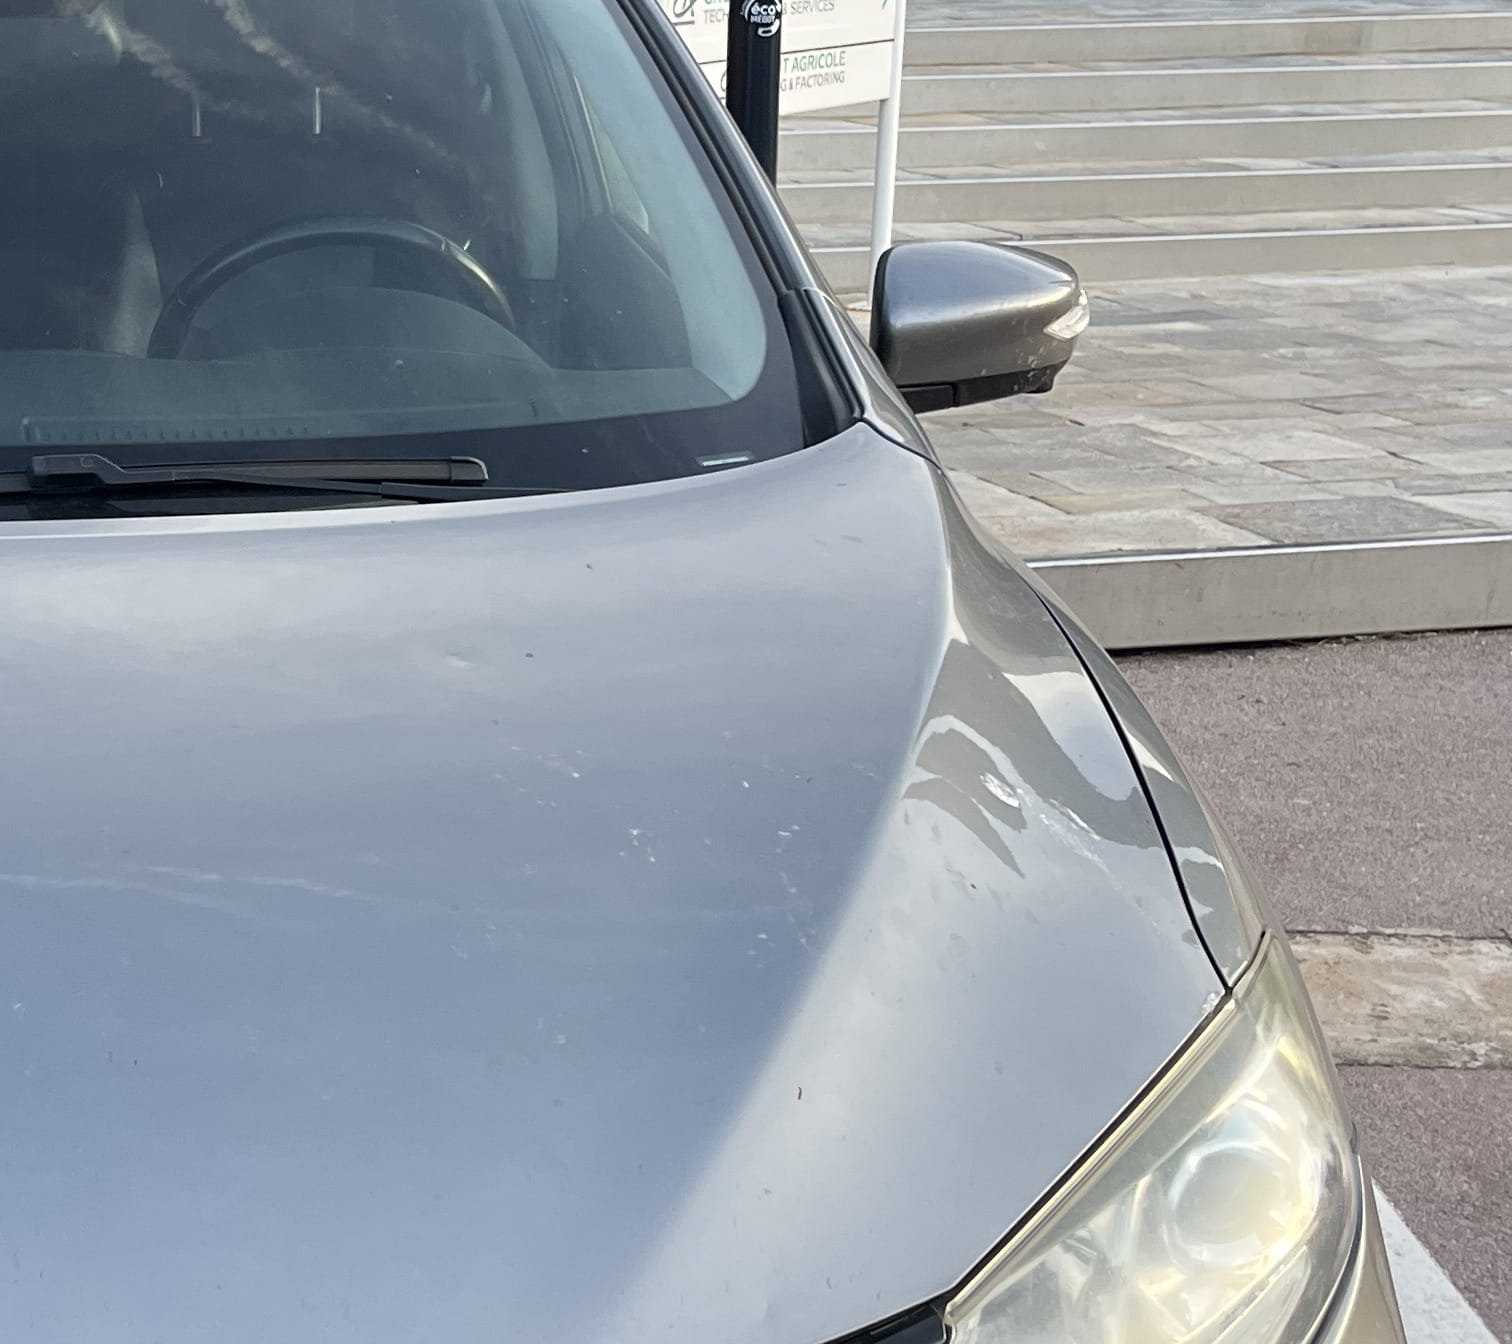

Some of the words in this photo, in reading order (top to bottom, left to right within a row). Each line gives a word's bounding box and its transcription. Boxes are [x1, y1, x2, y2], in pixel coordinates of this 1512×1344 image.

[751, 2, 776, 15] éco
[791, 50, 846, 73] AGRICOLE
[795, 70, 845, 88] FACTORING
